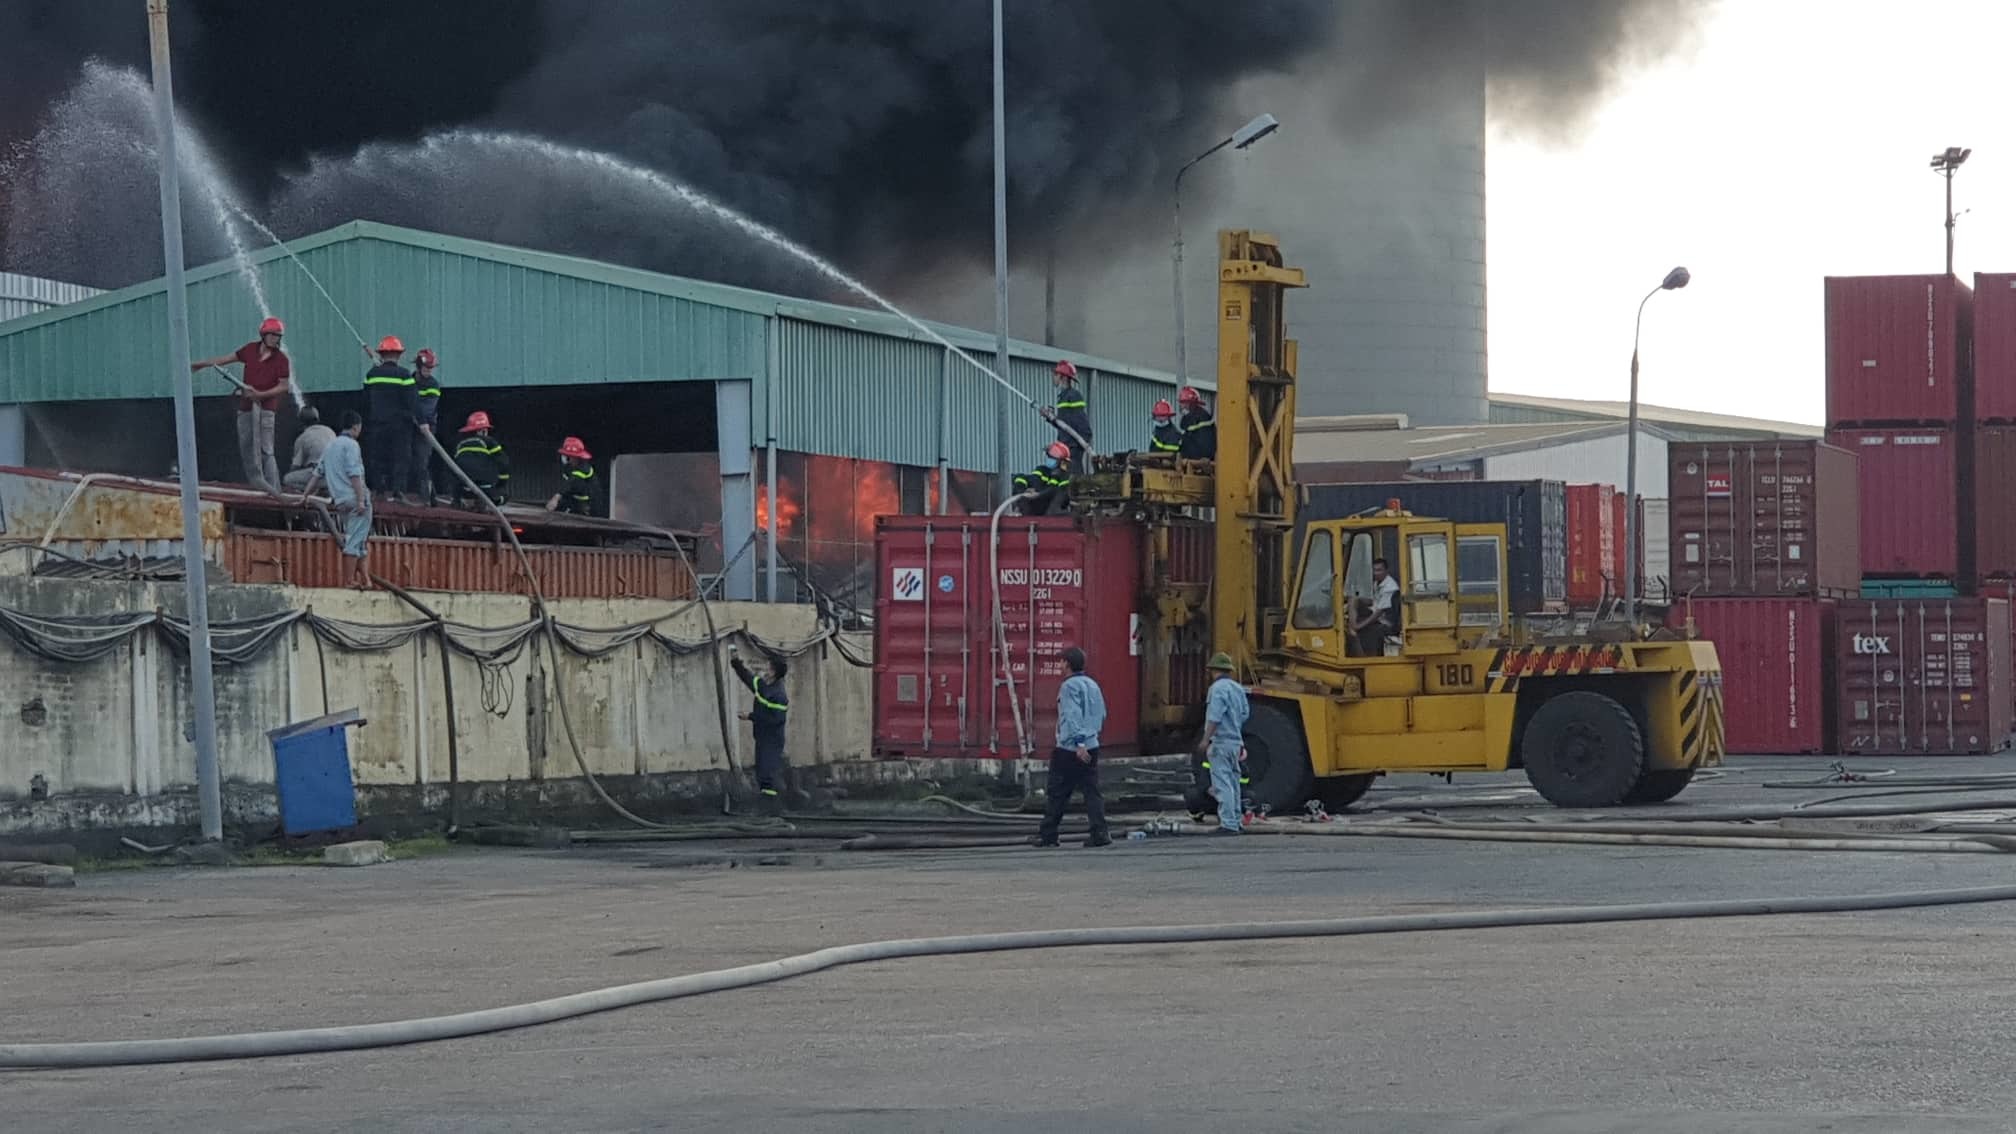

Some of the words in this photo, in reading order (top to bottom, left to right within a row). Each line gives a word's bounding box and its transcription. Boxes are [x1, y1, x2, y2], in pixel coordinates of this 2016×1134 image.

[1707, 480, 1729, 488] TAL
[1001, 569, 1028, 585] NSSU
[1852, 632, 1890, 654] tex
[1436, 663, 1473, 686] 180
